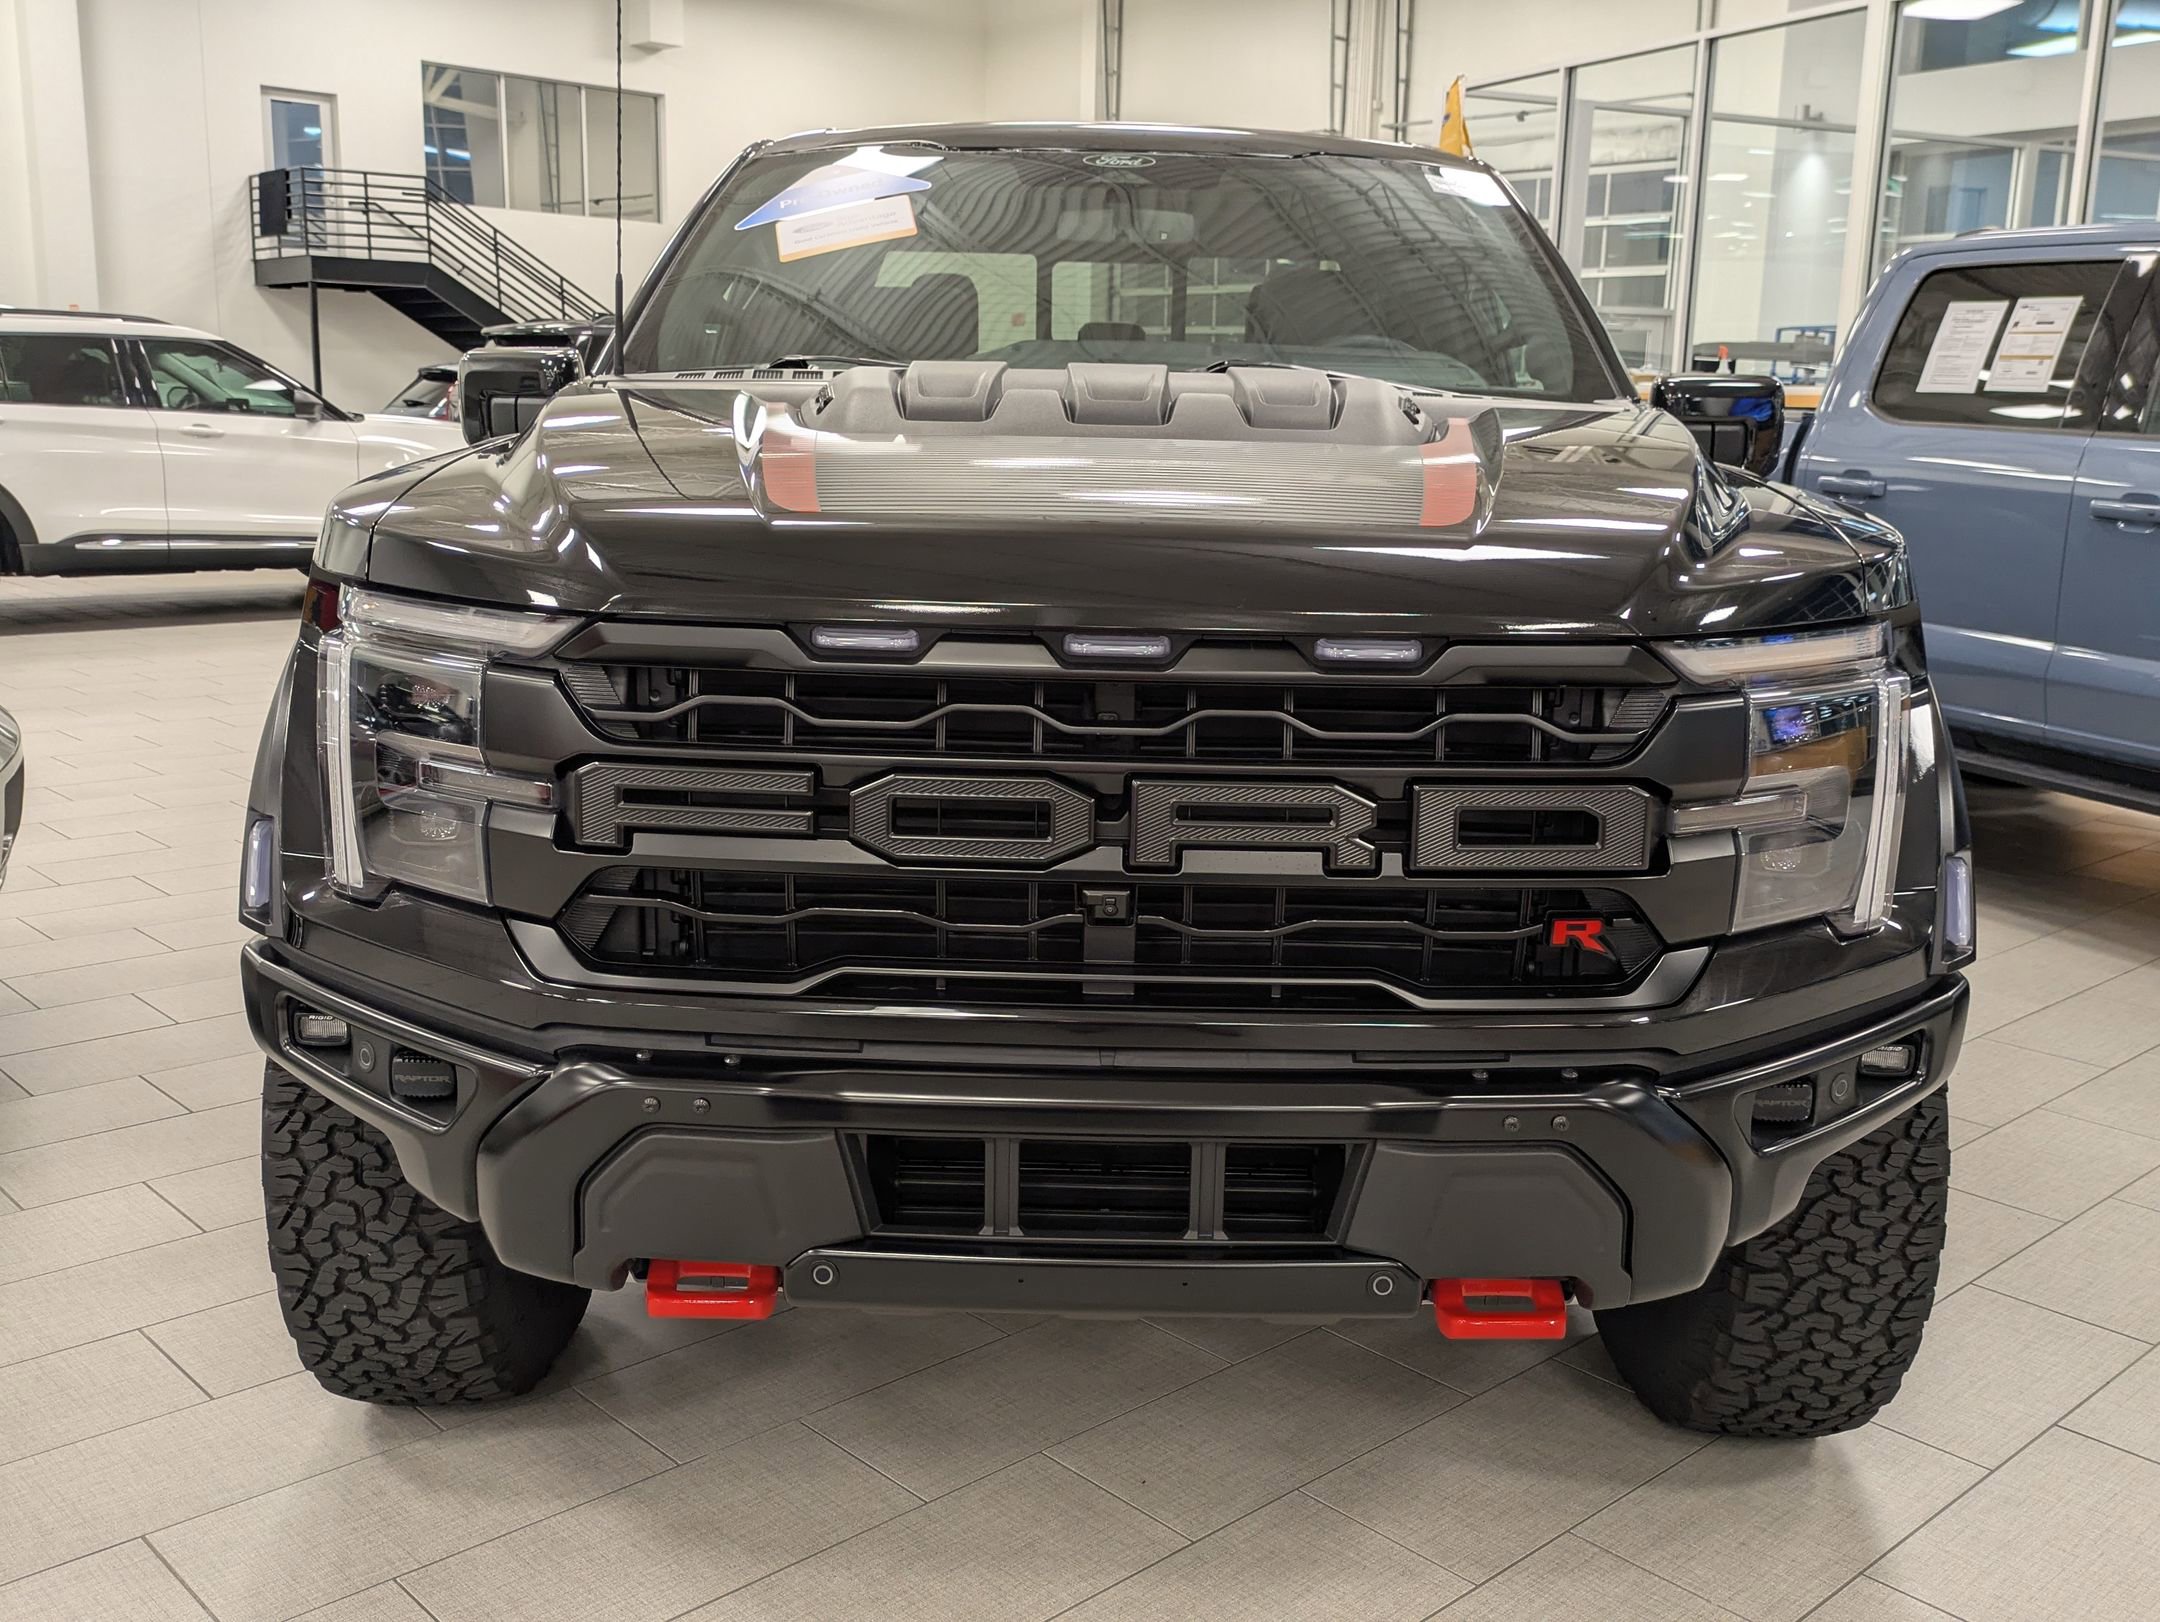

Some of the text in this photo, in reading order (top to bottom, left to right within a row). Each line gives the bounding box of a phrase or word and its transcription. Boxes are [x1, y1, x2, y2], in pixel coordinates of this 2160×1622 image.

[1095, 154, 1144, 167] Ford
[575, 761, 1652, 872] FORD
[1550, 918, 1614, 958] R
[394, 1074, 451, 1084] RAPTOR
